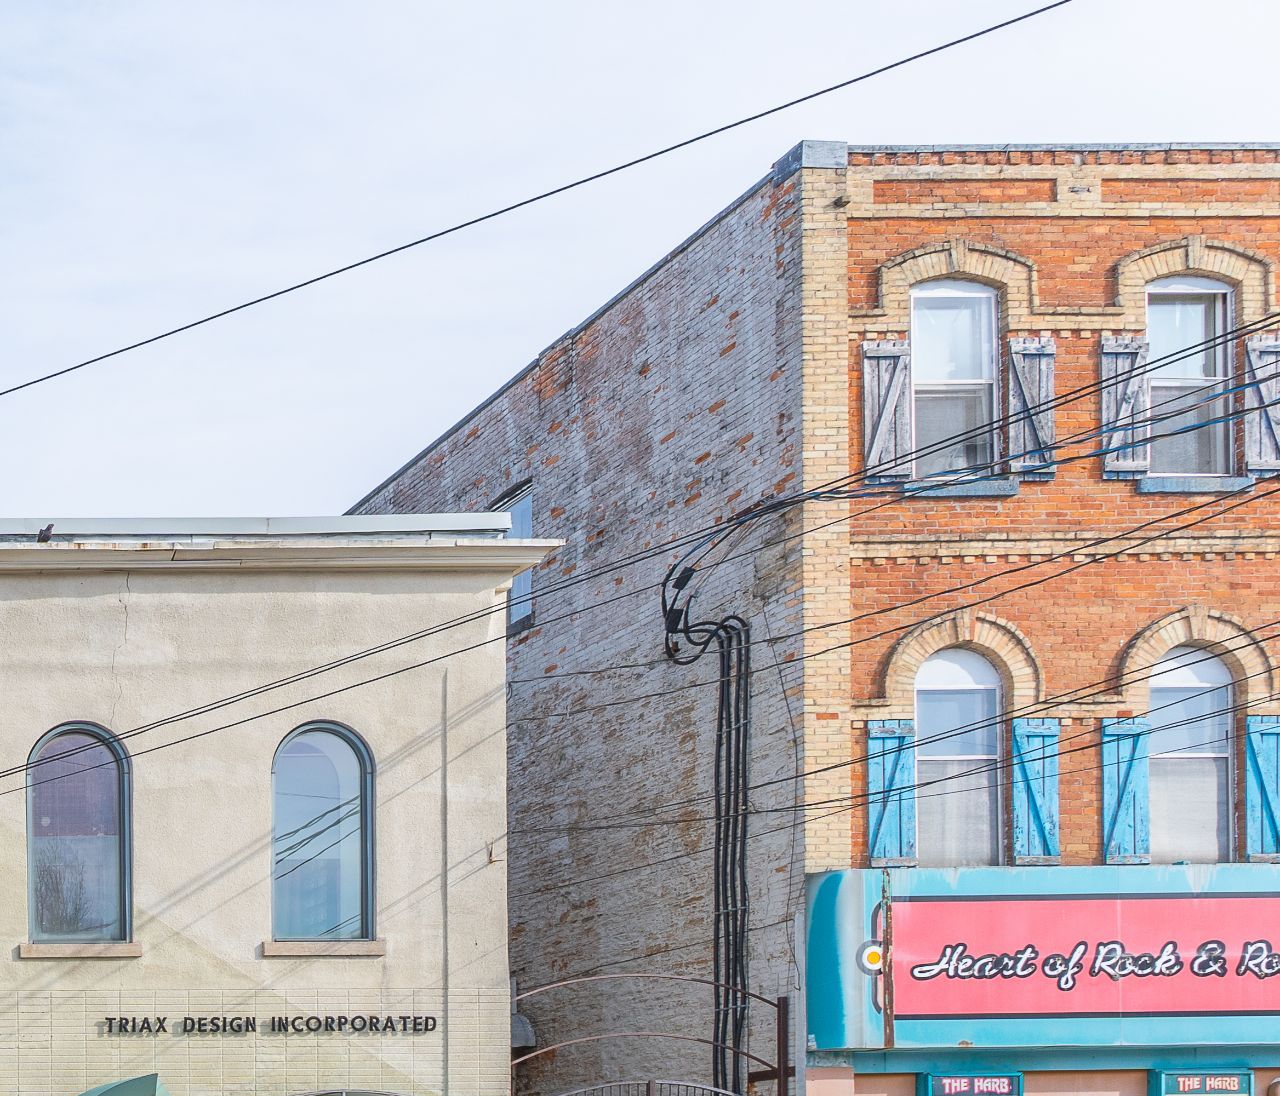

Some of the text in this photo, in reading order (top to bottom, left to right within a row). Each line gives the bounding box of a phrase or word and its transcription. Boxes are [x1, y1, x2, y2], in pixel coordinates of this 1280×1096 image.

[912, 944, 1037, 979] Heart
[1044, 942, 1087, 990] of
[1091, 942, 1182, 979] Rock
[1192, 940, 1227, 977] &
[105, 1015, 437, 1033] TRIAX DESIGN INCORPORATED
[942, 1078, 1010, 1095] THE HARB
[1177, 1076, 1239, 1092] THE HARB
